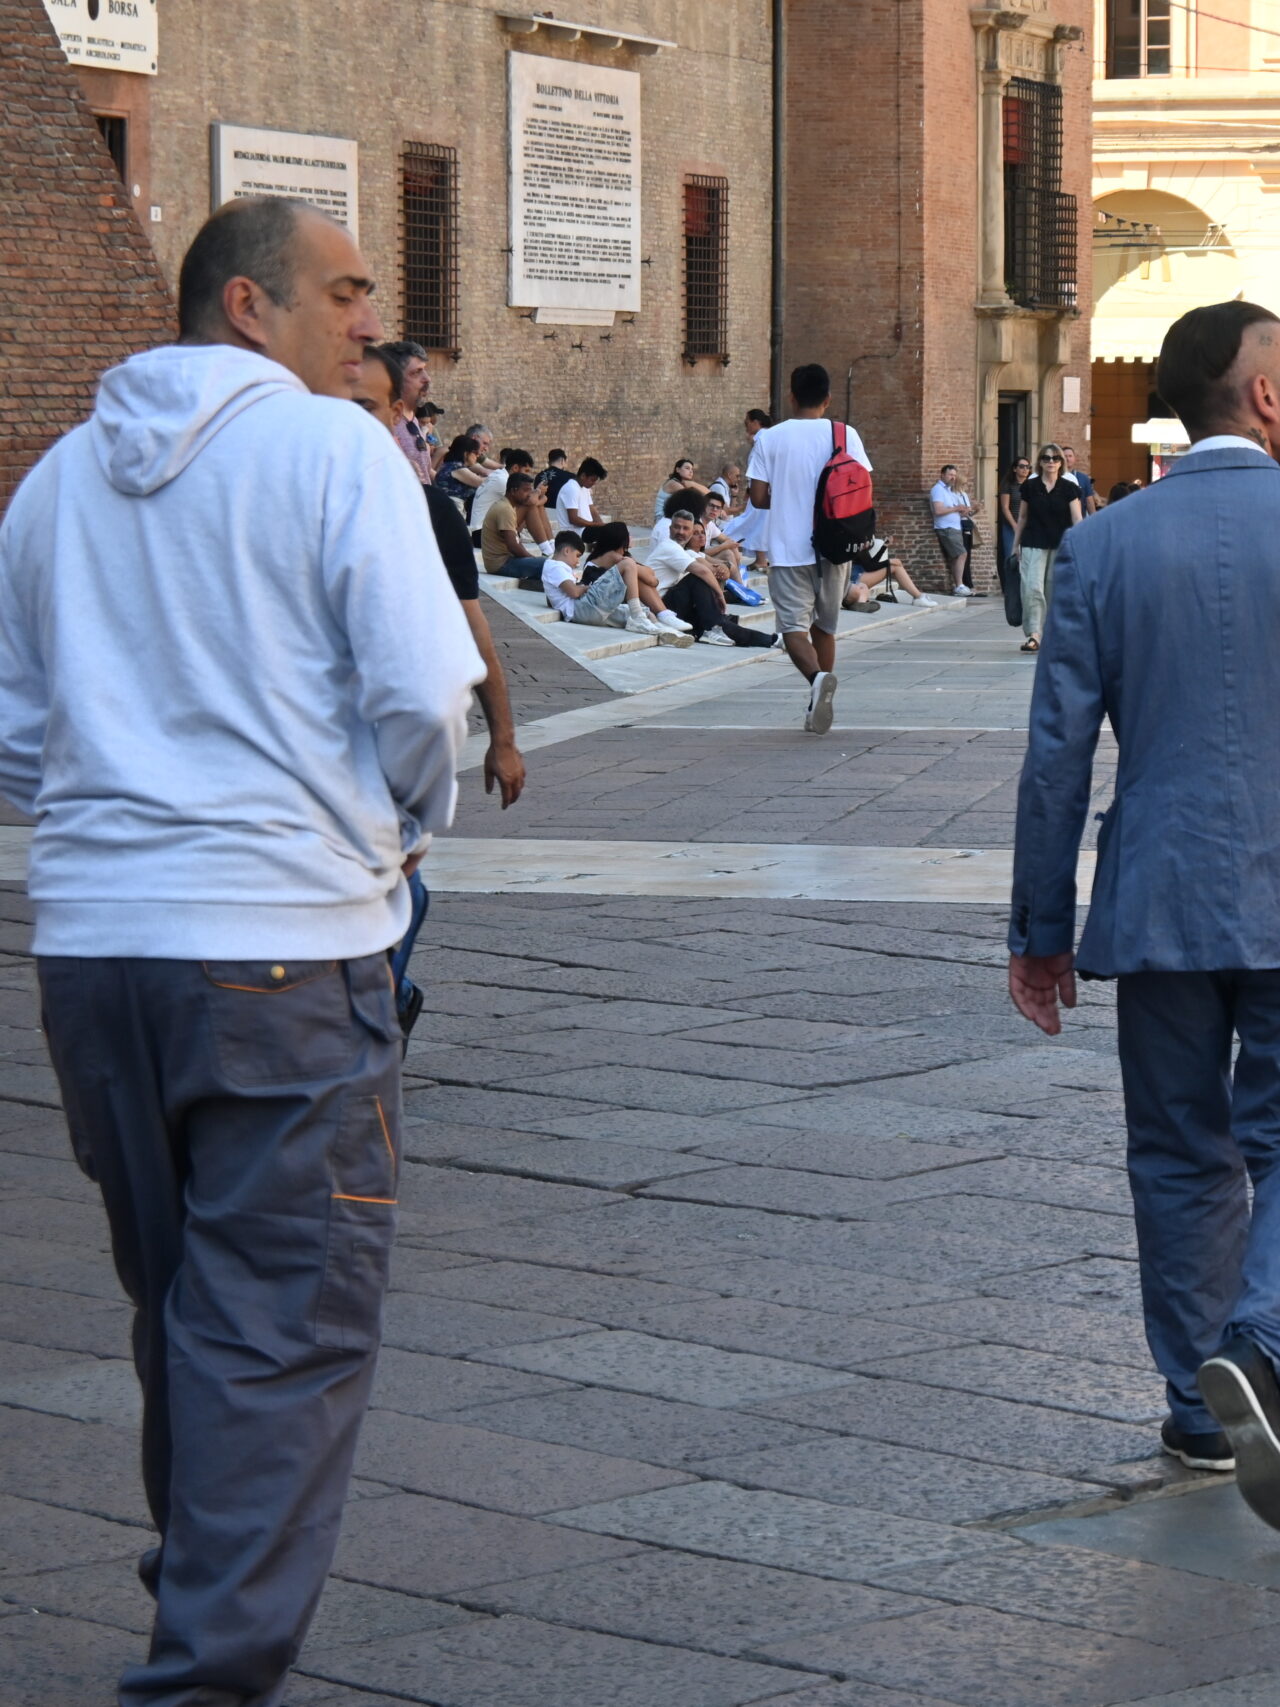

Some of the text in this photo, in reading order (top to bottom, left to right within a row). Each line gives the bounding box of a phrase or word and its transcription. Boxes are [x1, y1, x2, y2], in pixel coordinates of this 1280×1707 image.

[109, 0, 139, 17] BORSA
[536, 83, 619, 105] BOLLETTINO DELLA VITTORIA
